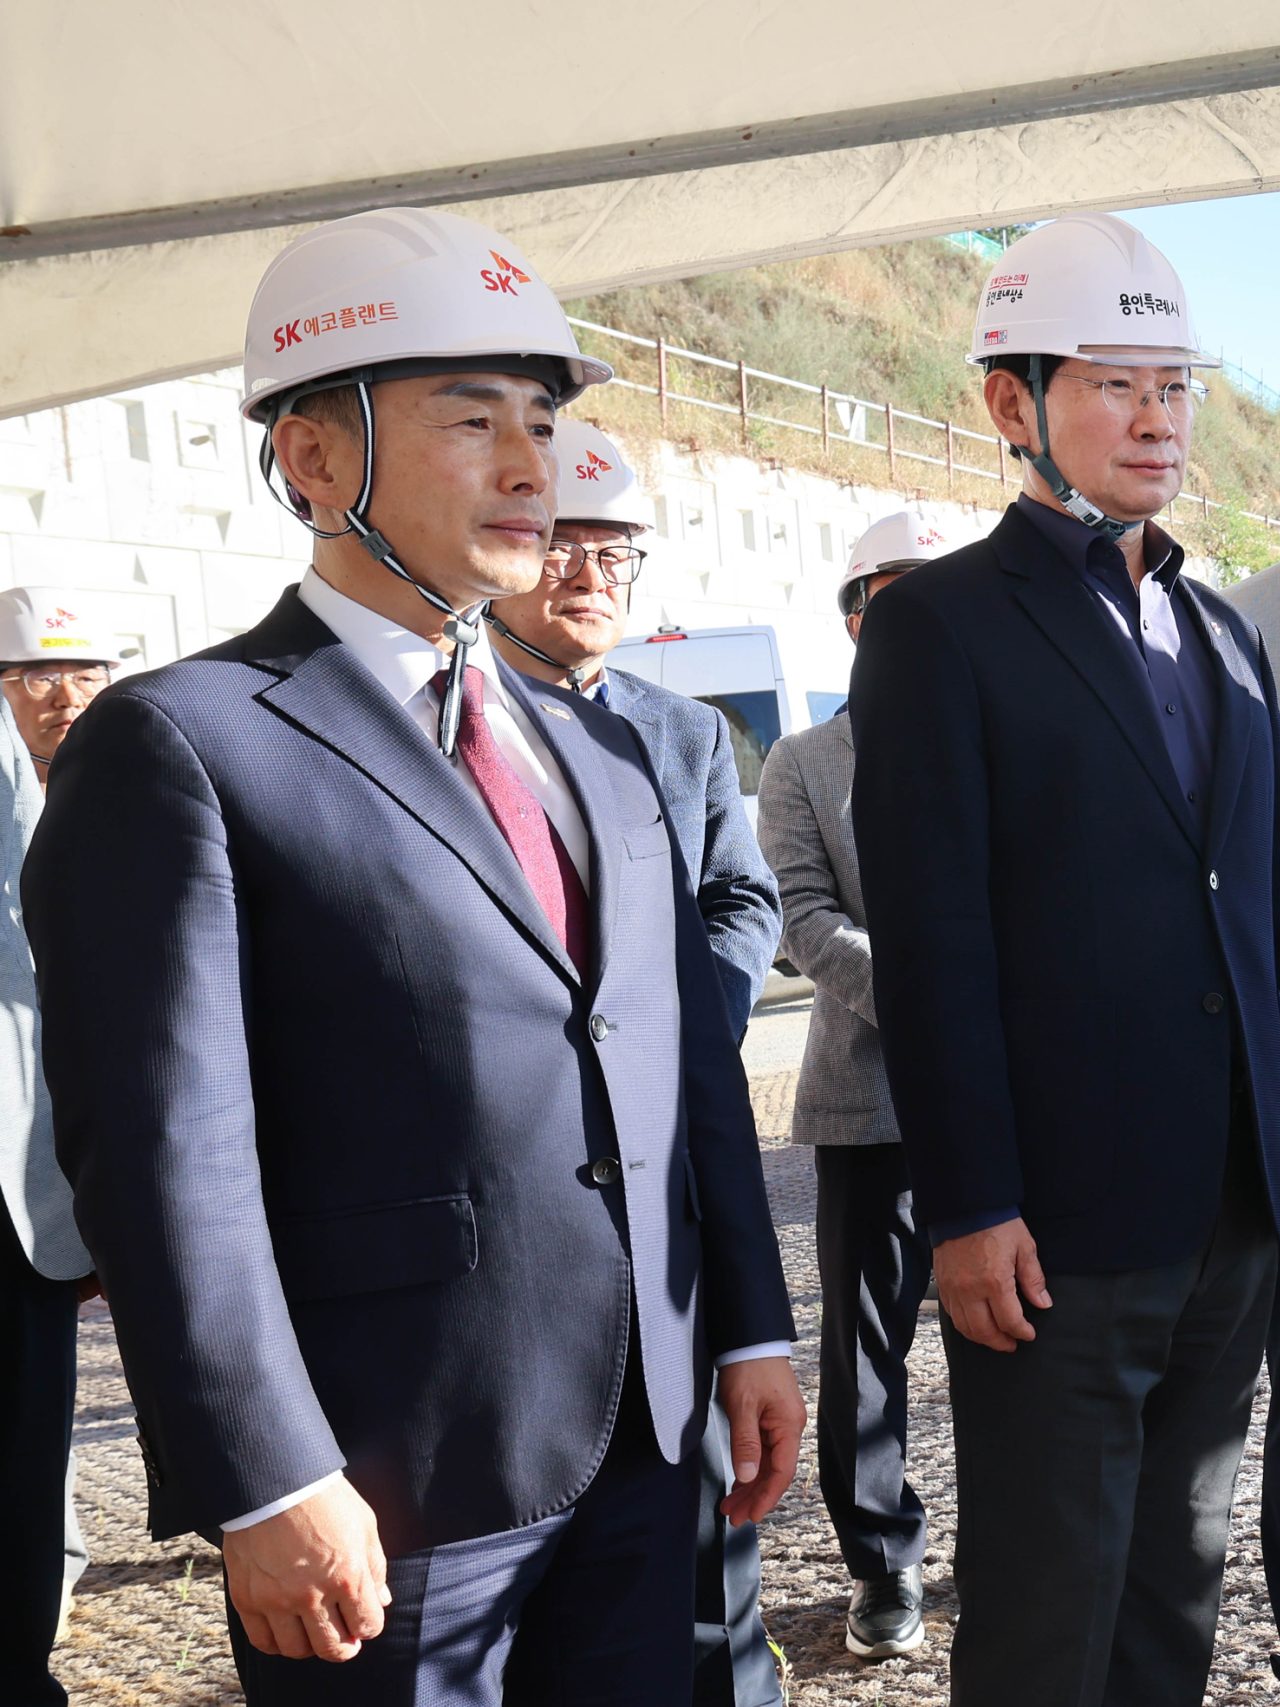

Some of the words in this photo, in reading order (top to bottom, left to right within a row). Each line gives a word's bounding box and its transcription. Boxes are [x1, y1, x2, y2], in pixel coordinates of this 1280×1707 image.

[480, 269, 519, 296] SK
[1119, 293, 1180, 318] 용인특례시
[575, 464, 600, 482] SK
[917, 536, 935, 547] SK
[46, 618, 65, 628] SK
